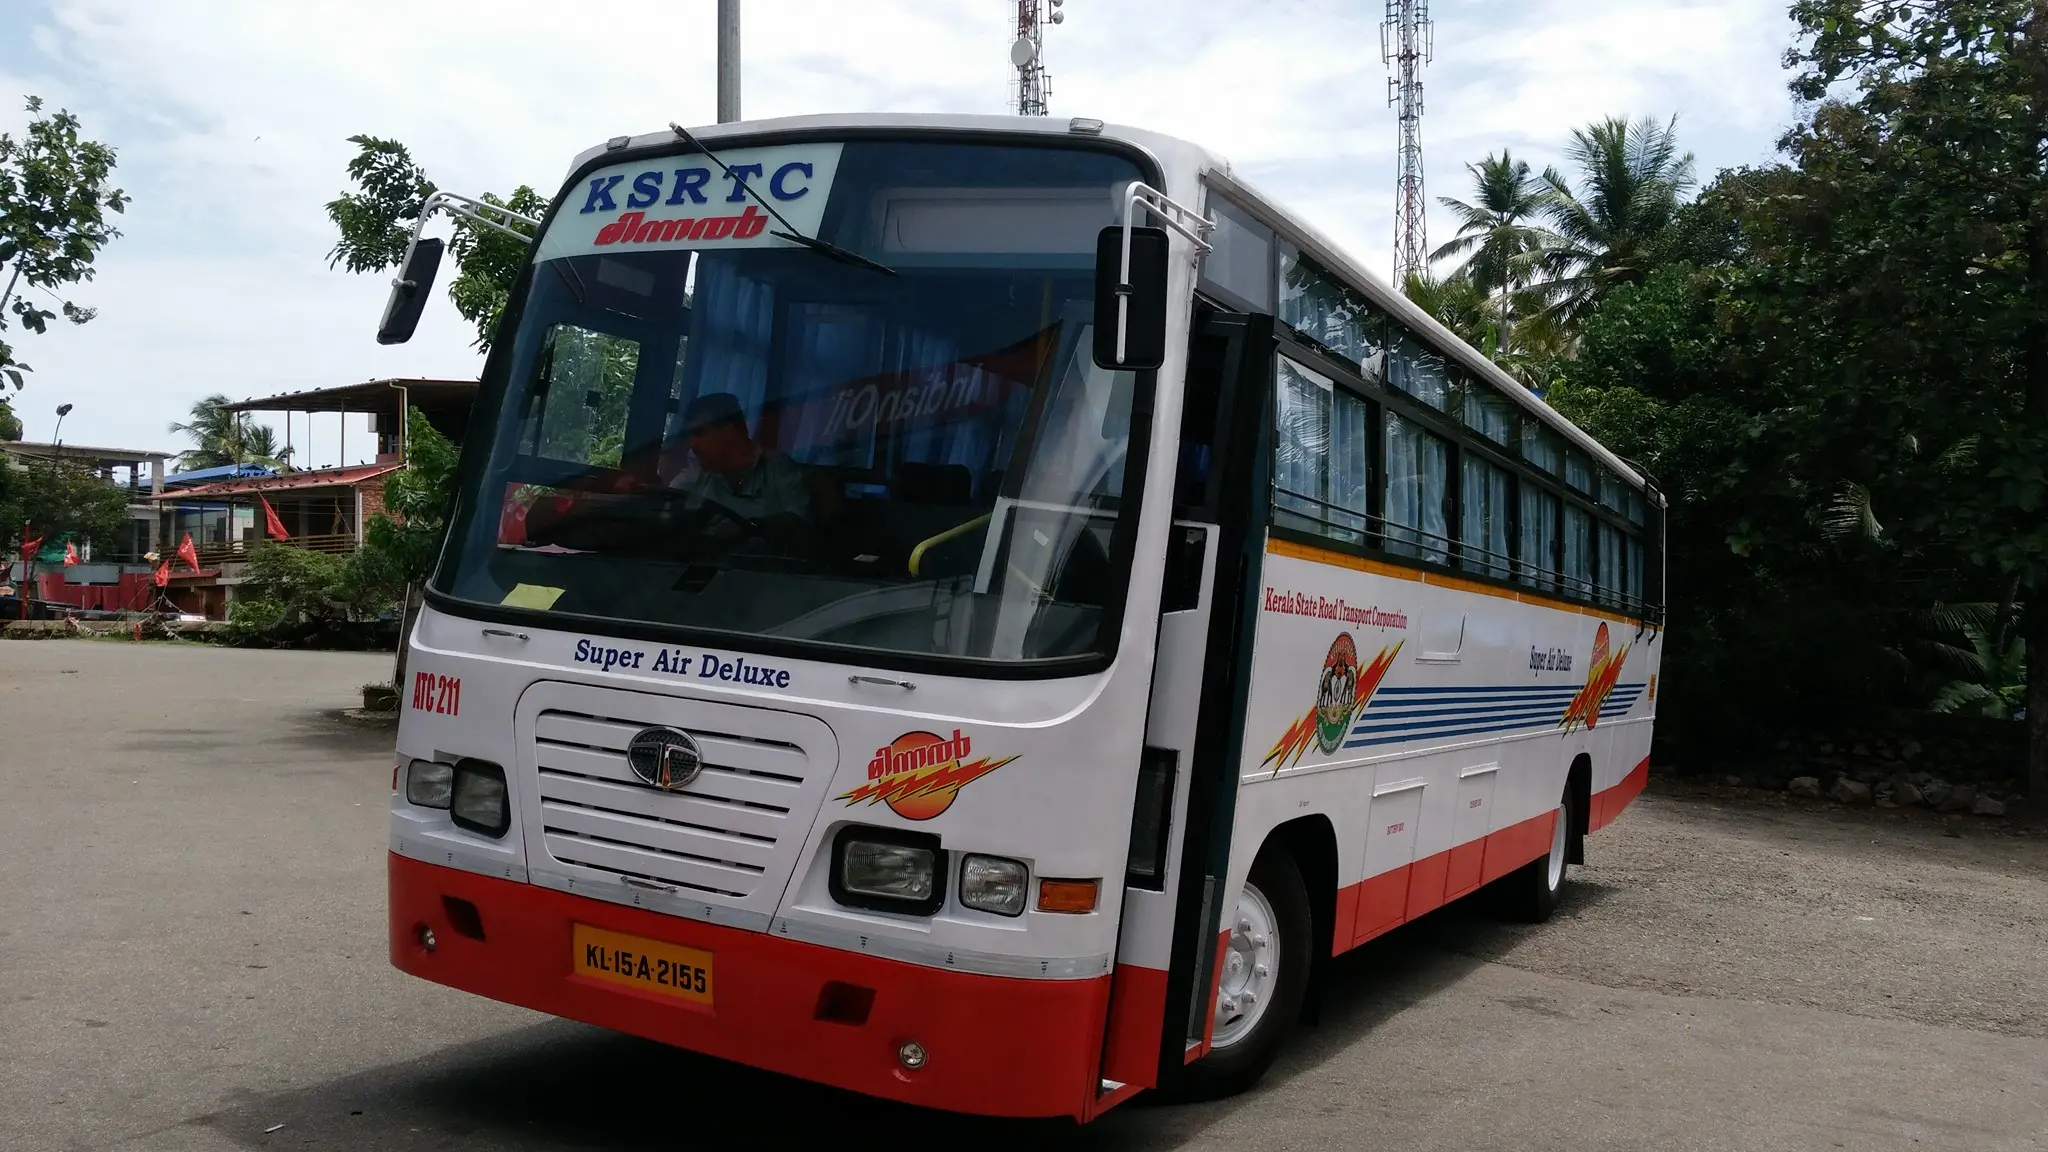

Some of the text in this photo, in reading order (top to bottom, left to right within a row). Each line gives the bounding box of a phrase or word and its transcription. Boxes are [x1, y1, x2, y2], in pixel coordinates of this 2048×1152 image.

[580, 162, 813, 214] KSRTC
[1264, 587, 1407, 632] Kerala State Road Transport Corporation
[574, 639, 790, 688] Super Air Deluxe
[1529, 645, 1547, 678] Super
[1546, 647, 1556, 671] Air
[1555, 648, 1572, 672] Deluxe
[412, 671, 461, 717] ATC 211
